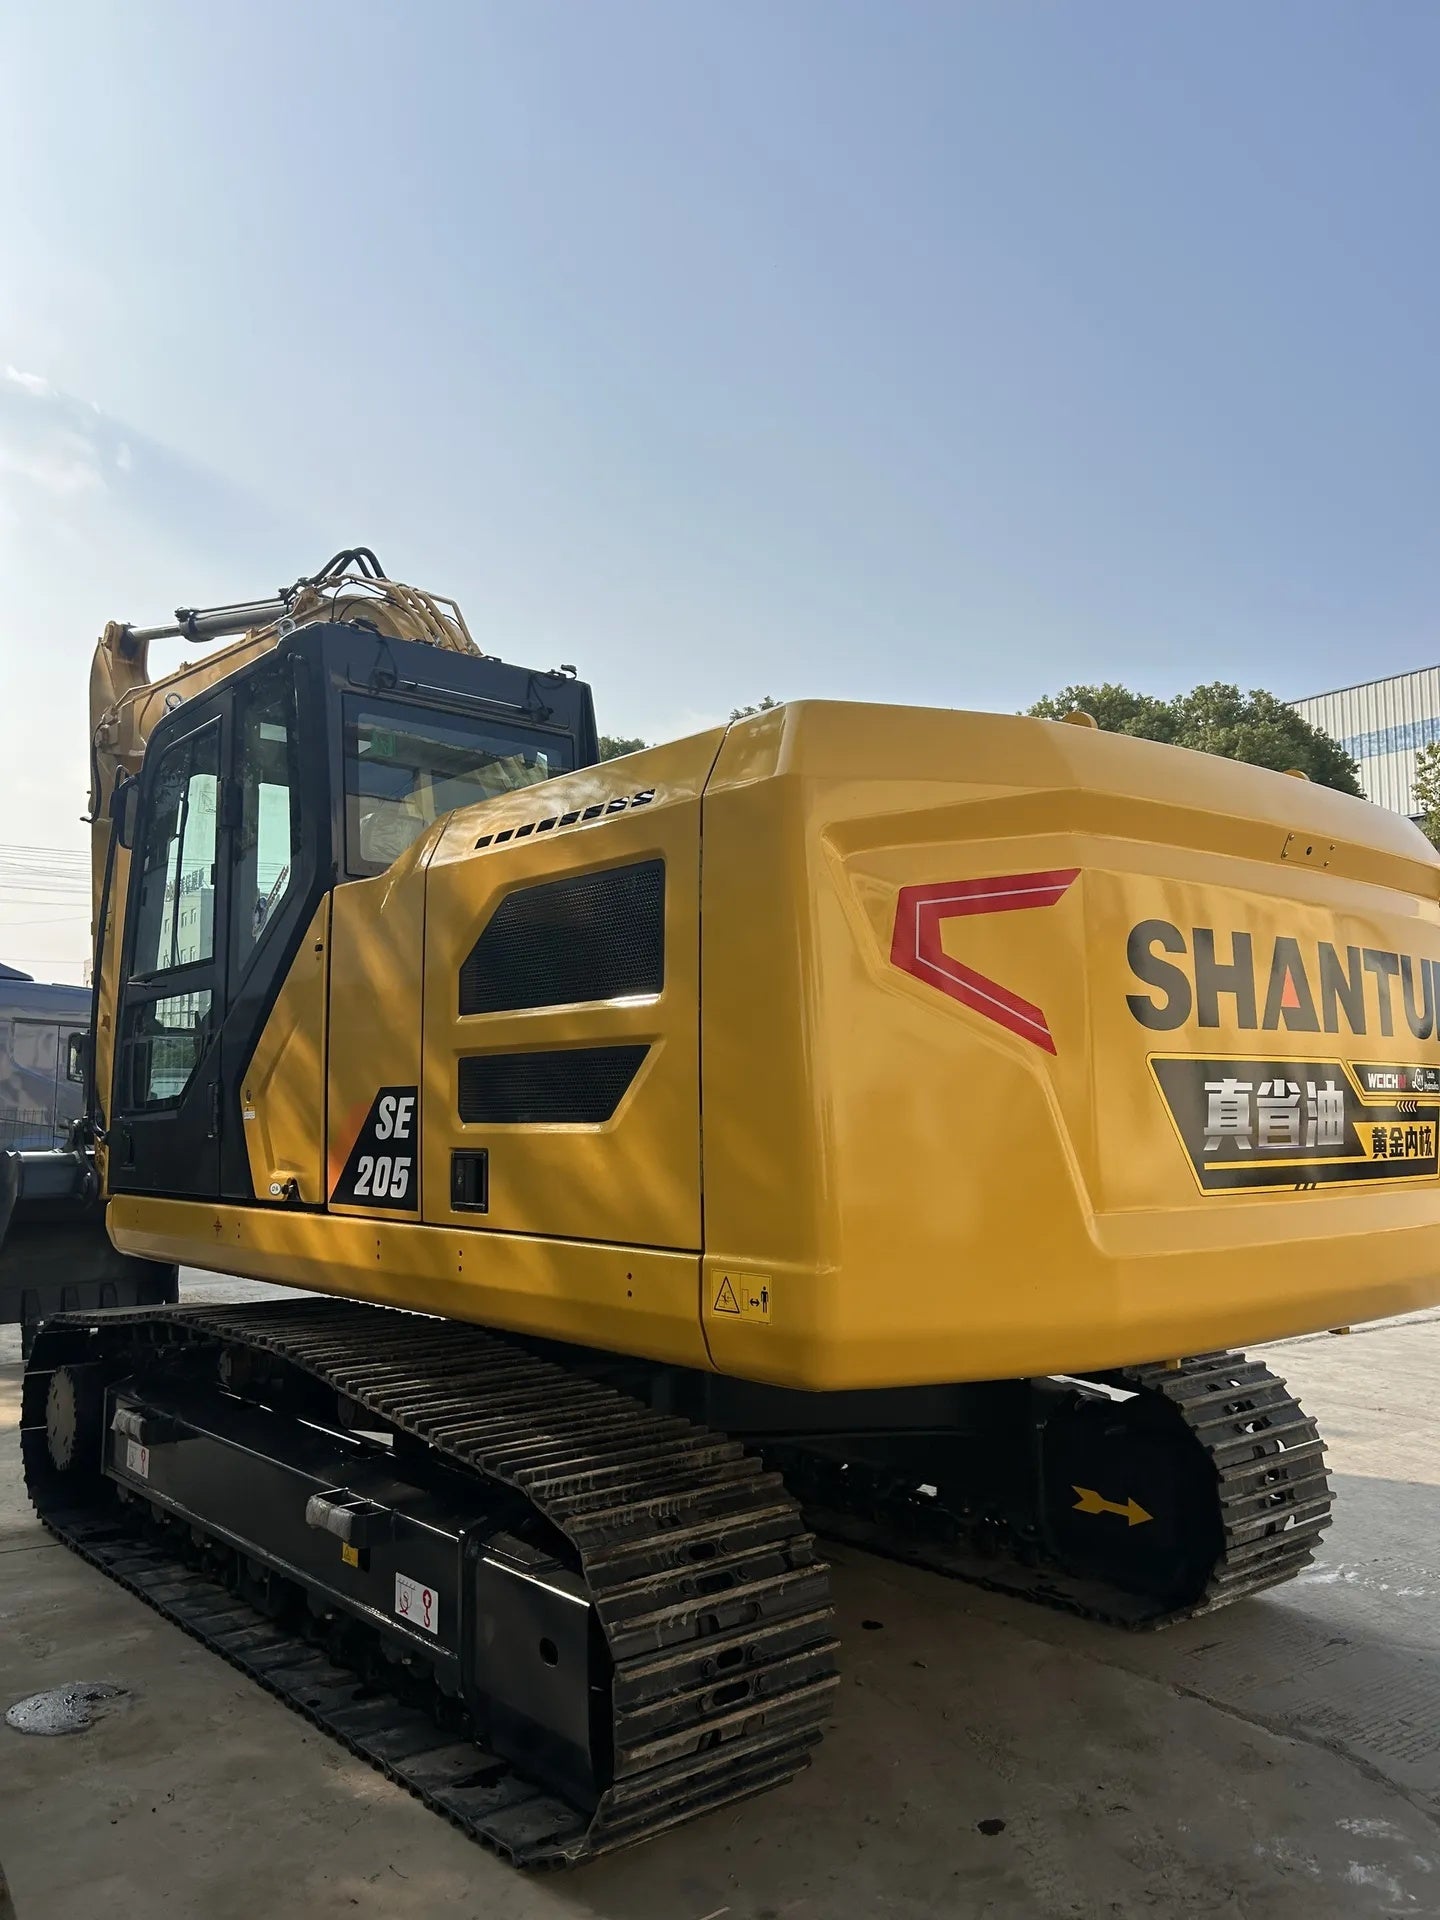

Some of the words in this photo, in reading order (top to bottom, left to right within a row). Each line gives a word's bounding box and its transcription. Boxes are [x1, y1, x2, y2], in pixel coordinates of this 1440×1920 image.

[375, 1095, 415, 1140] SE
[1203, 1078, 1344, 1151] 真省油
[1372, 1125, 1433, 1159] 黄金内核
[353, 1155, 412, 1199] 205
